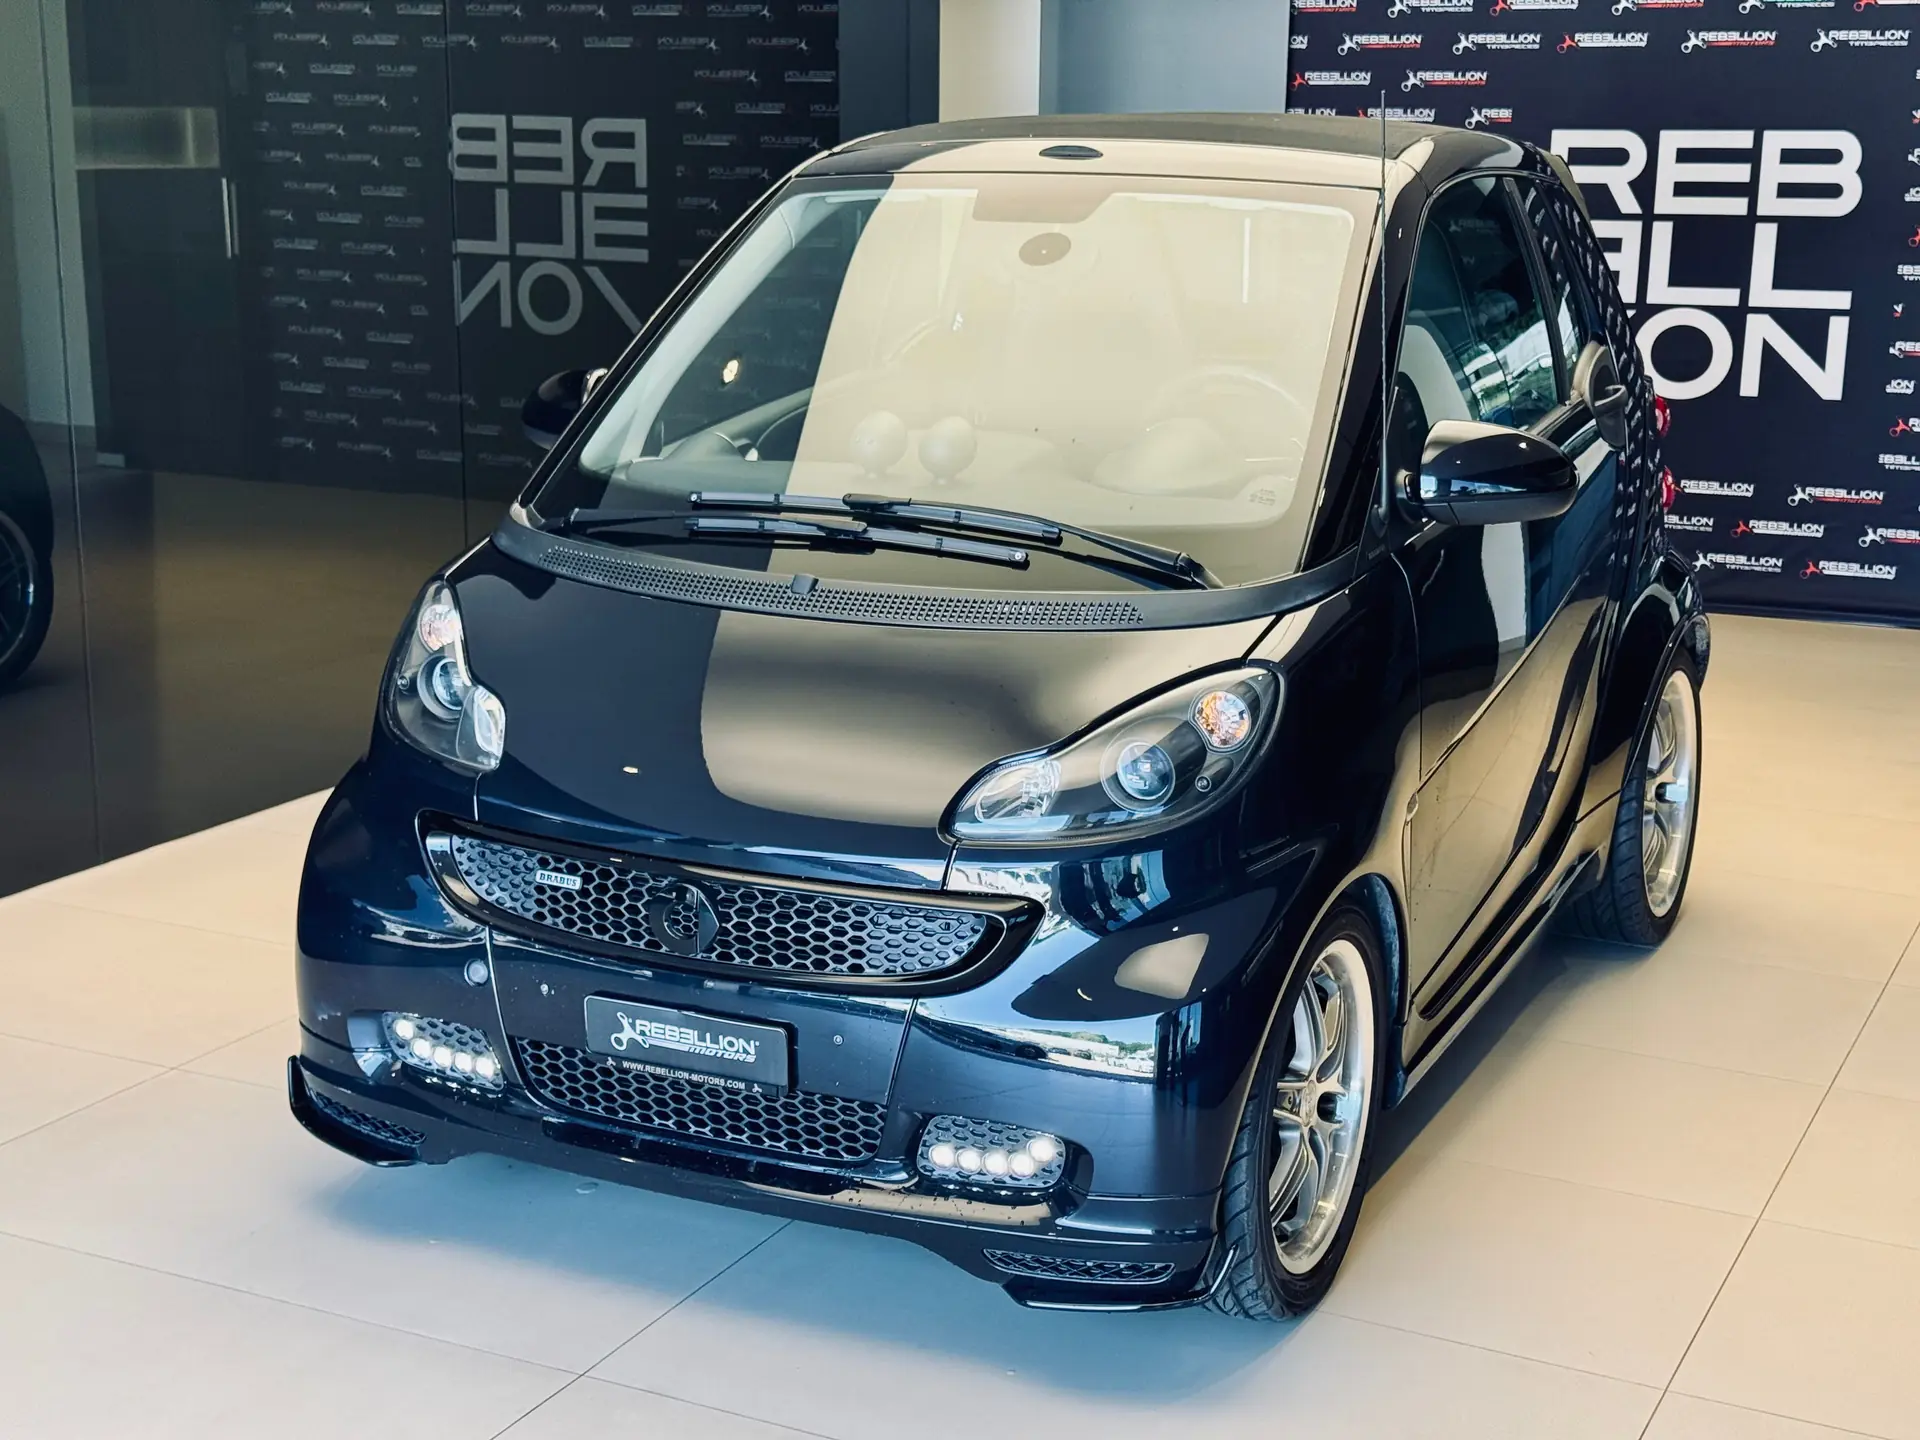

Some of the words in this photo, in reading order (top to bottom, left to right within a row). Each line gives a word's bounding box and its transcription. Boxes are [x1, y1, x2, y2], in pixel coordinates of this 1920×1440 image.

[1352, 34, 1421, 44] REBELLION
[1468, 34, 1540, 43] REBELLION
[1574, 32, 1648, 42] REBELLION
[1699, 31, 1777, 41] REBELLION
[1828, 30, 1909, 40] REBELLION
[1304, 72, 1371, 81] REBELLION
[1416, 72, 1487, 81] REBELLION
[1550, 129, 1863, 218] REB
[1626, 307, 1850, 401] ON
[1680, 480, 1754, 493] REBELLION
[1805, 487, 1884, 500] REBELLION
[1749, 520, 1824, 533] REBELLION
[1706, 553, 1784, 567] REBELLION
[1819, 560, 1897, 575] REBELLION
[539, 872, 578, 887] BRABUS
[634, 1020, 757, 1055] REBELLION
[688, 1046, 757, 1064] MOTORS
[622, 1060, 746, 1090] WWW.REBELLION-MOTORS.COM
